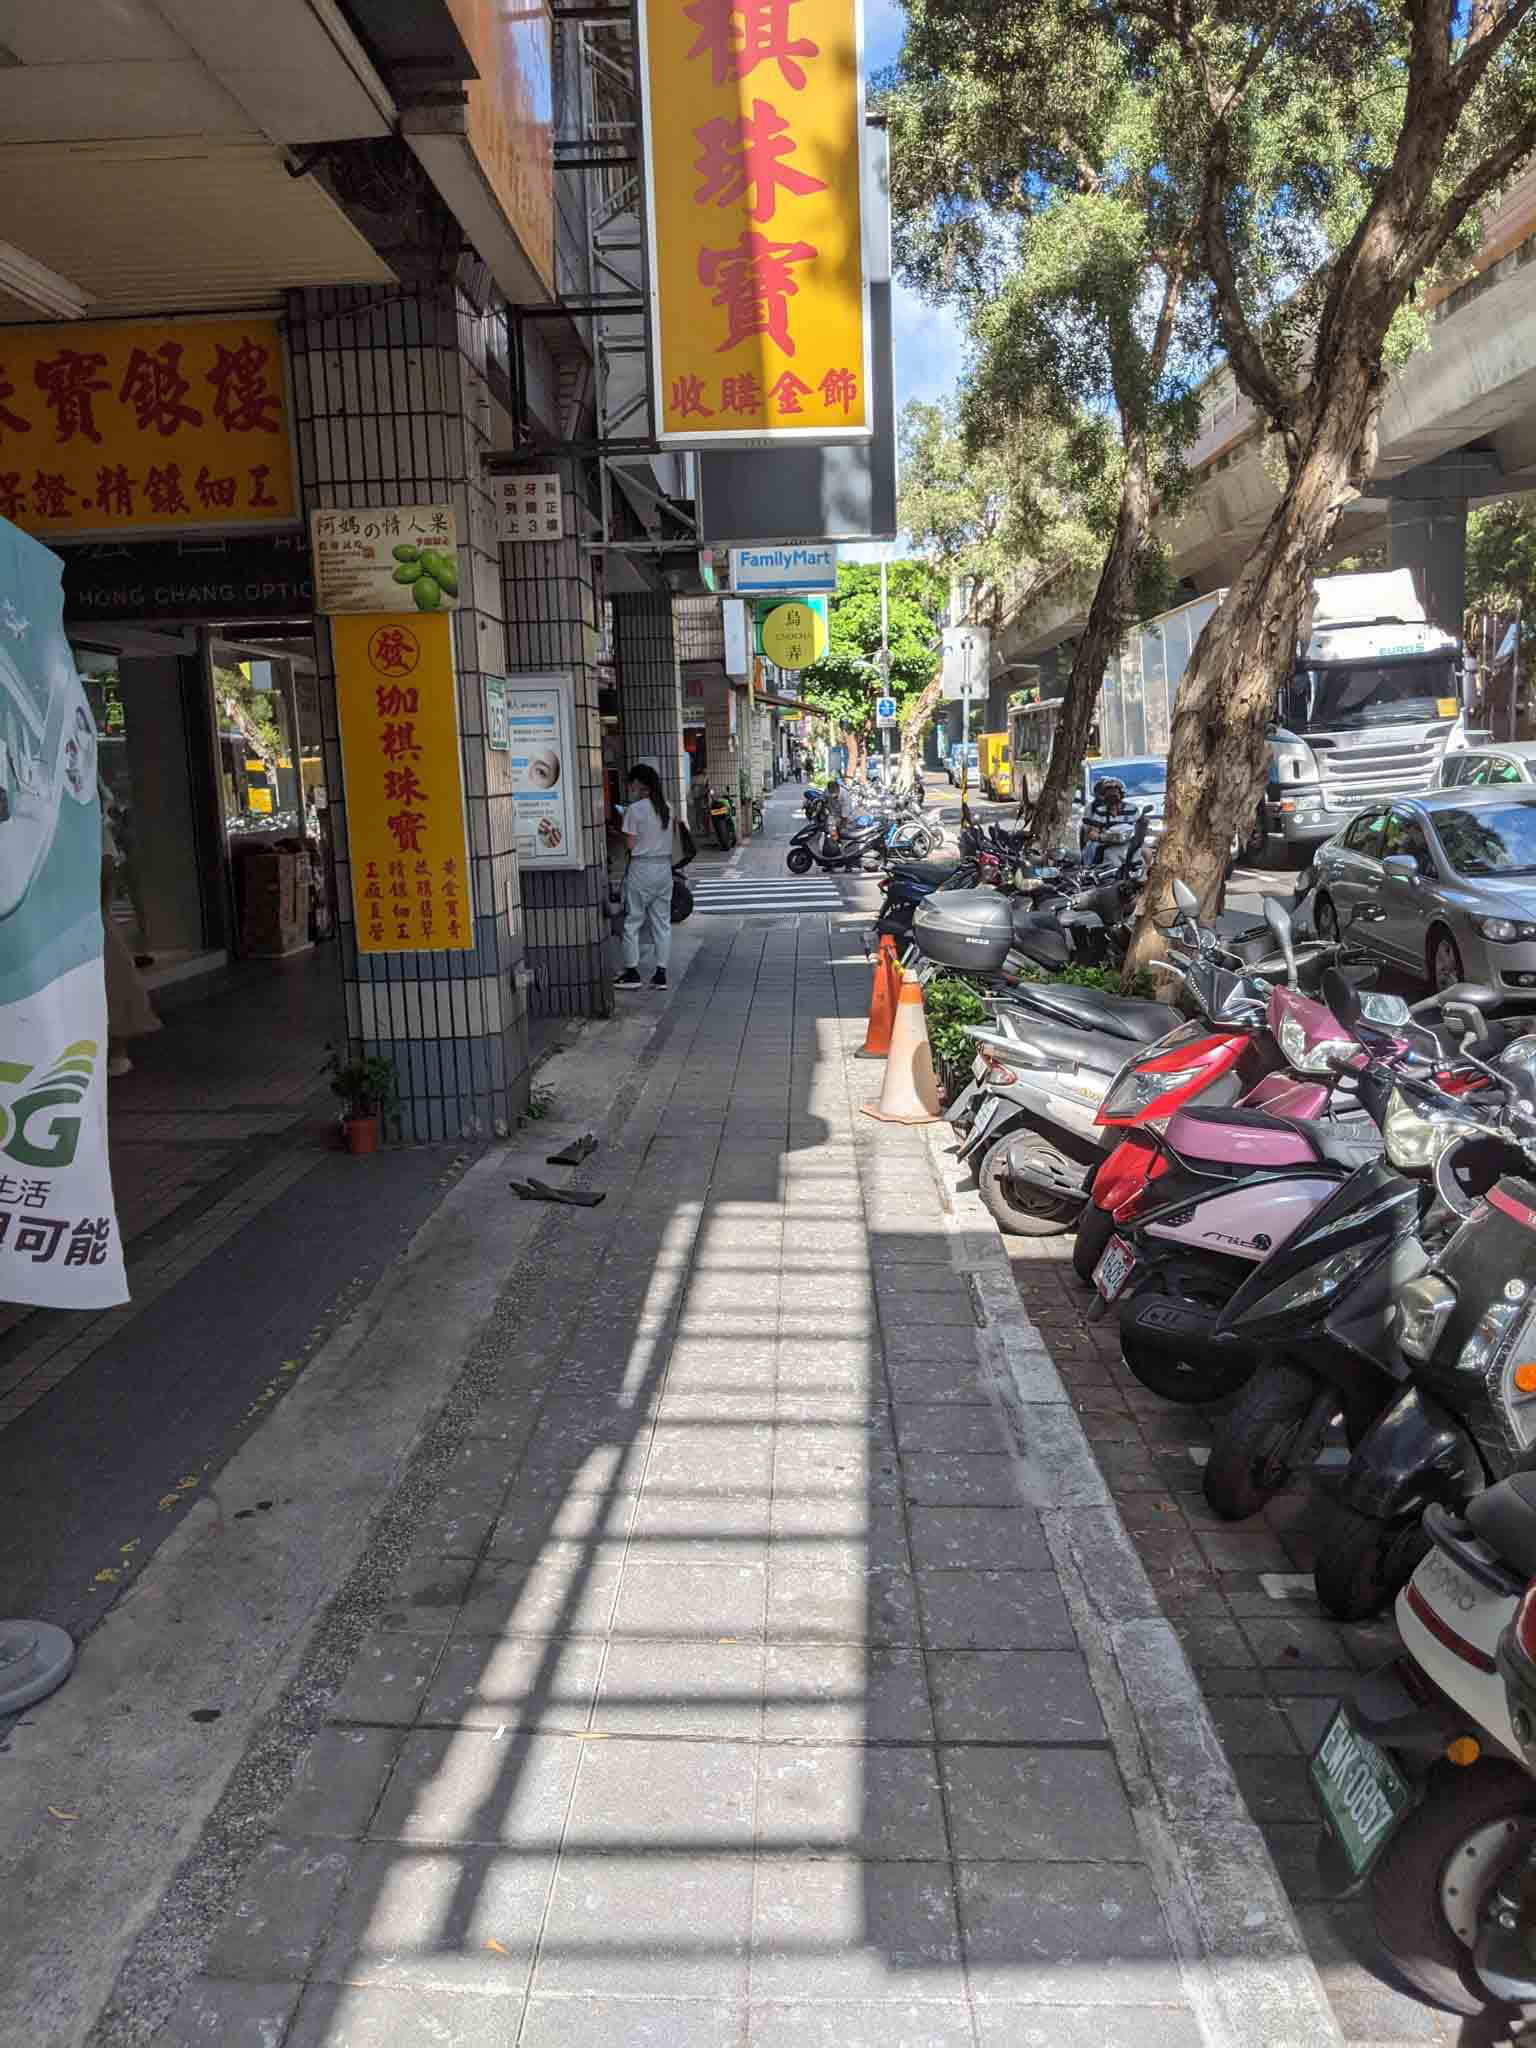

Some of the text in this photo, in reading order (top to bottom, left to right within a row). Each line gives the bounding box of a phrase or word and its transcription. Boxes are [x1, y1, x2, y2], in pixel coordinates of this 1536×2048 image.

[670, 367, 858, 419] 收購金飾
[740, 549, 831, 569] FamilyMart
[0, 1212, 110, 1266] 可能
